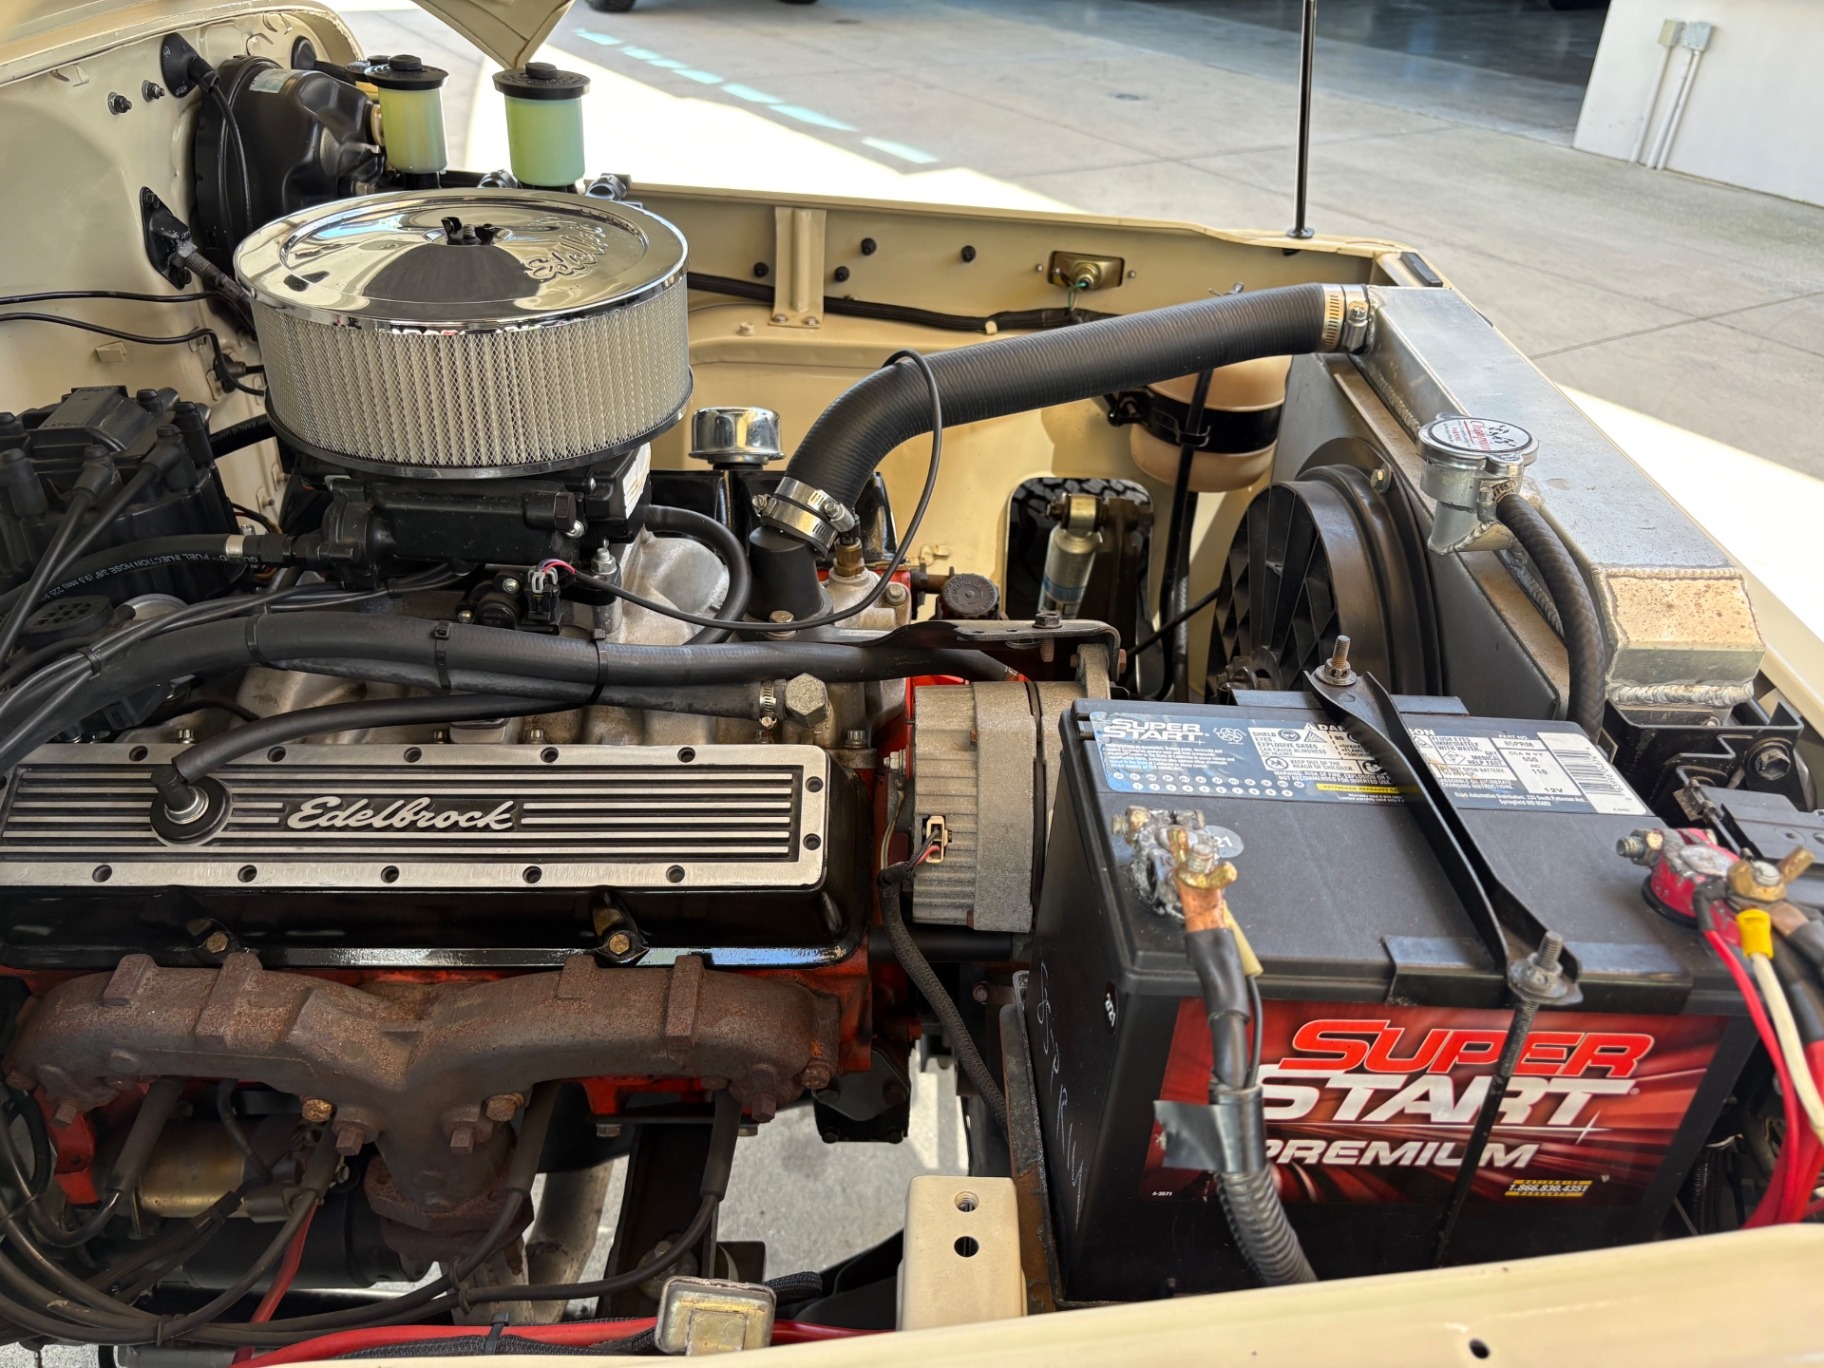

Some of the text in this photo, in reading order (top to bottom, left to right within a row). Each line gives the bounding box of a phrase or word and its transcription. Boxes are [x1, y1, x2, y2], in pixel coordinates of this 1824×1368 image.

[133, 553, 182, 567] INJECTION
[182, 552, 209, 562] FUEL
[108, 561, 134, 574] HOSE
[1111, 718, 1201, 732] SUPER
[1102, 726, 1204, 742] START
[287, 795, 514, 830] Edelbrock
[1279, 1019, 1655, 1077] SUPER
